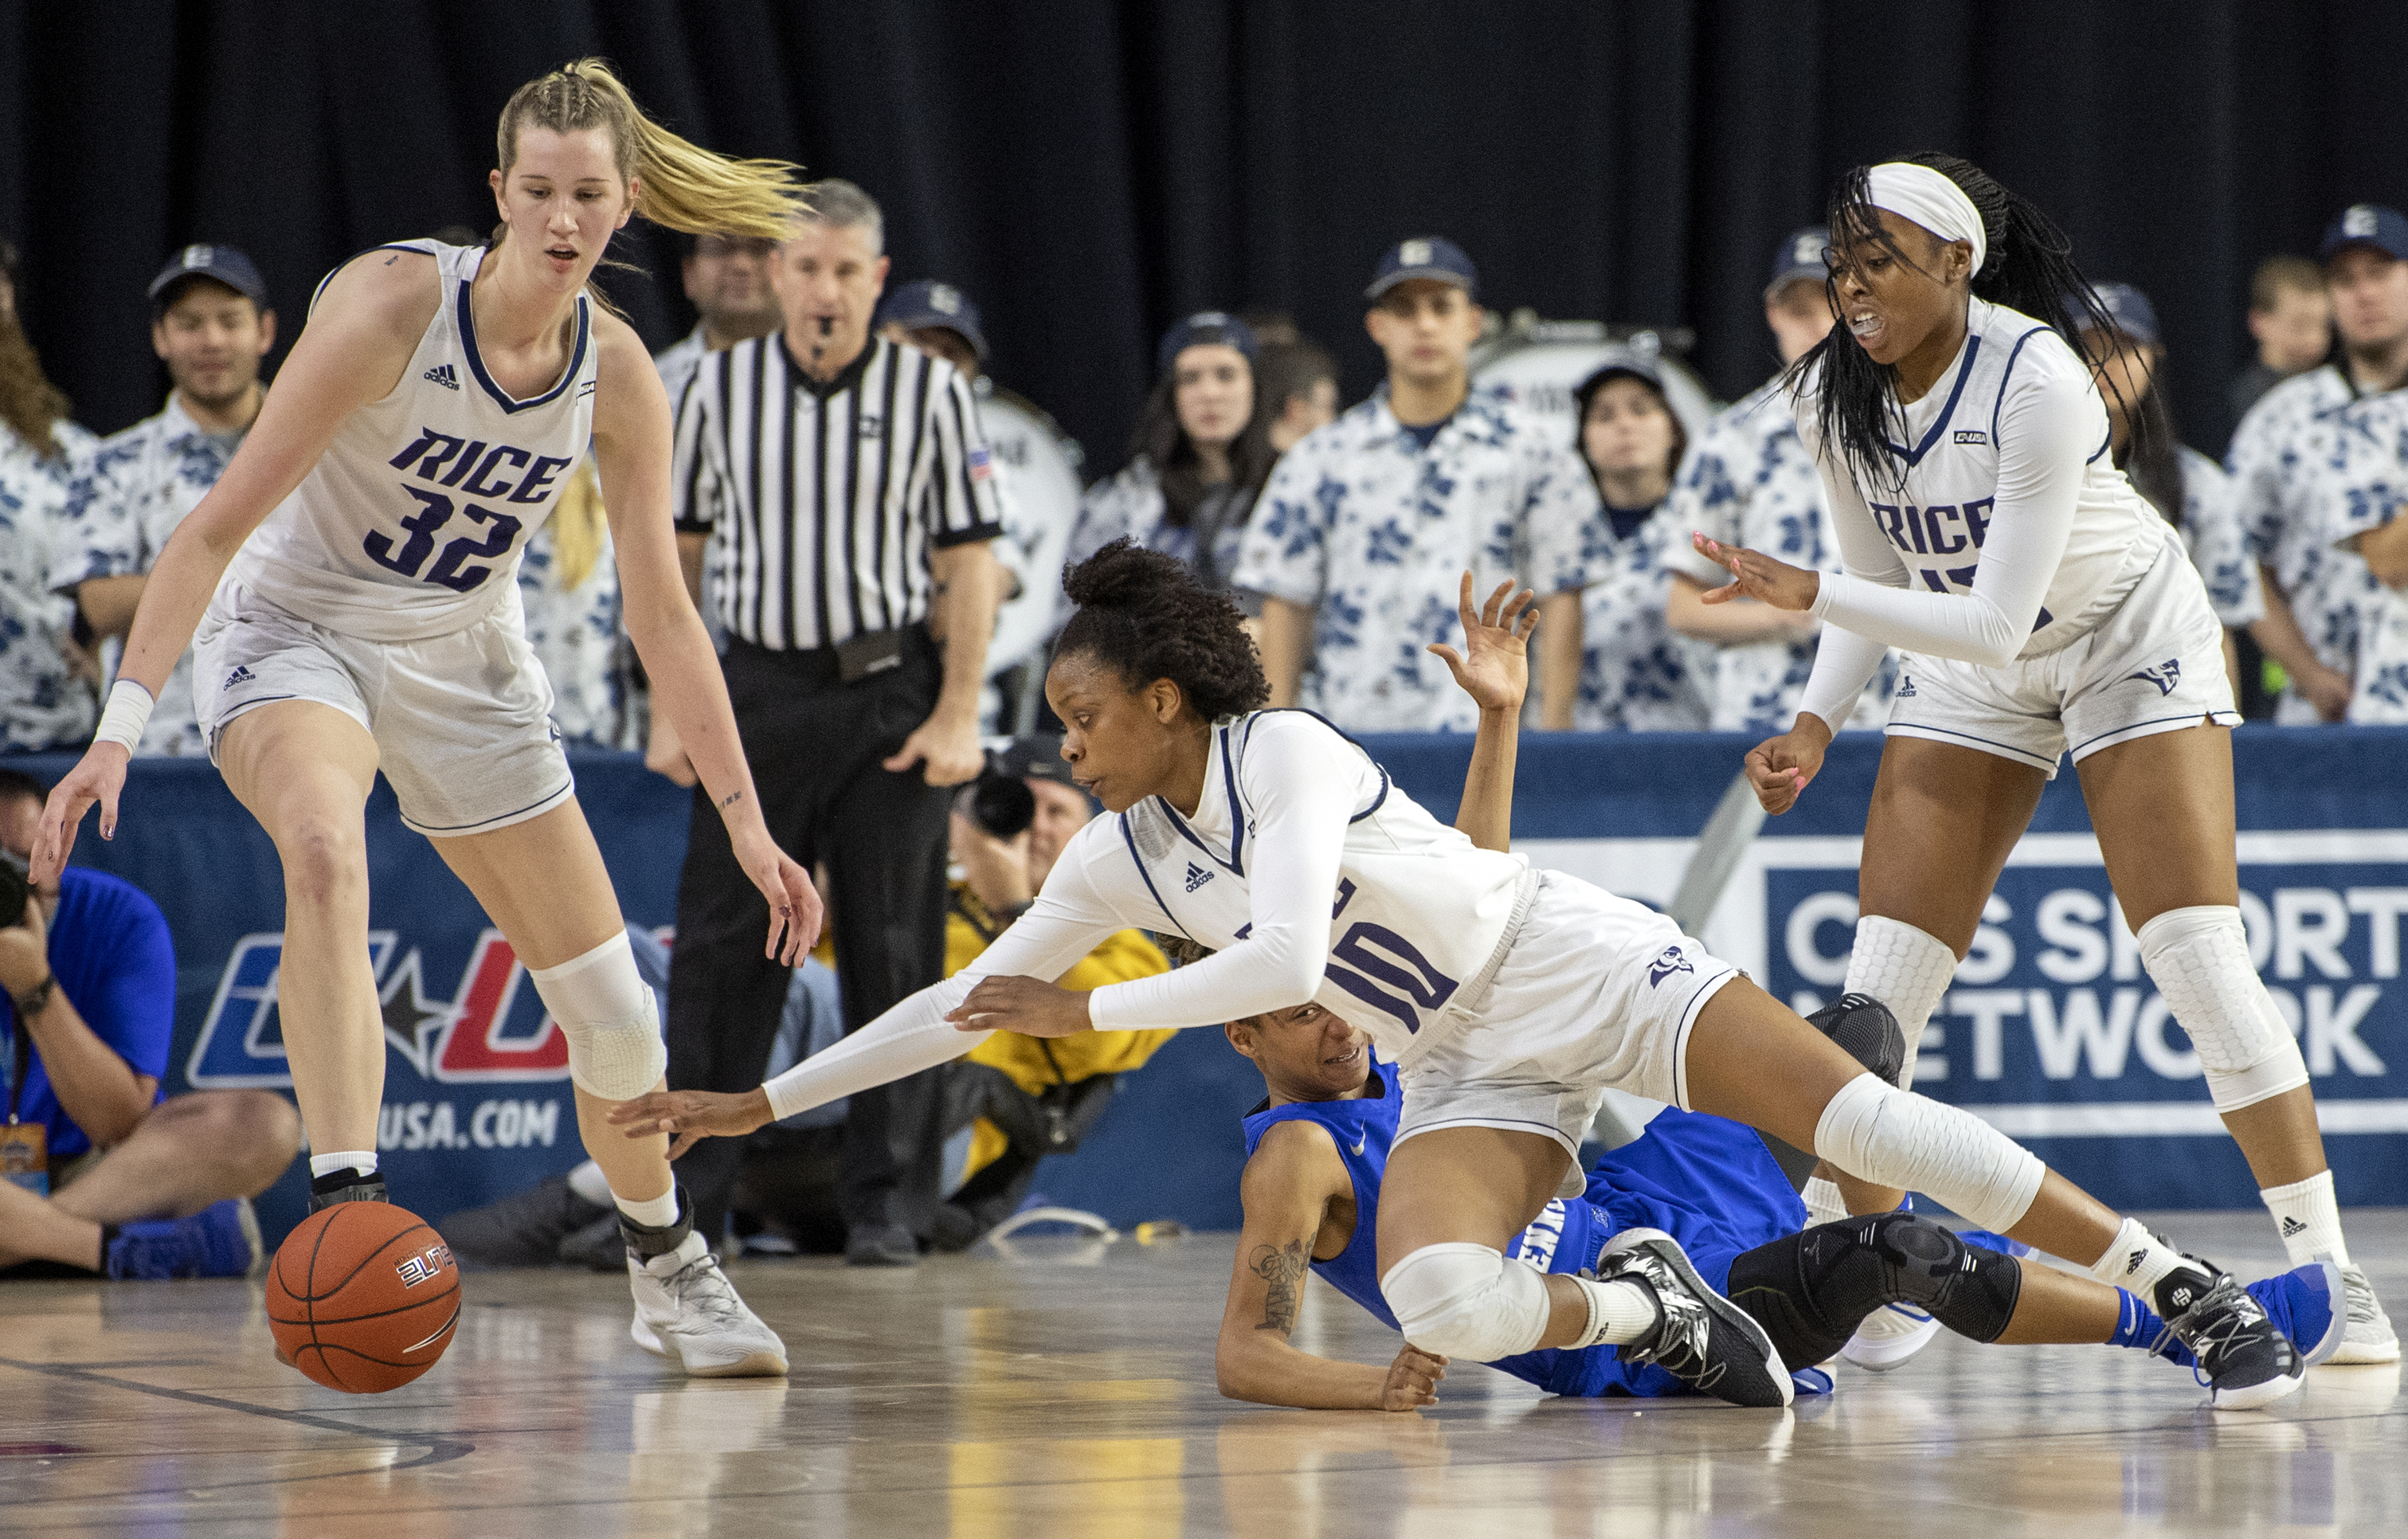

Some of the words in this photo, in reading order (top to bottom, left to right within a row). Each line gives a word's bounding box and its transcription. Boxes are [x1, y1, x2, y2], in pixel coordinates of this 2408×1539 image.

[424, 372, 460, 391] adidas
[388, 426, 573, 503] RICE
[363, 483, 523, 593] 32
[224, 674, 256, 691] adidas
[1186, 871, 1215, 892] adidas
[1324, 922, 1459, 1035] 10
